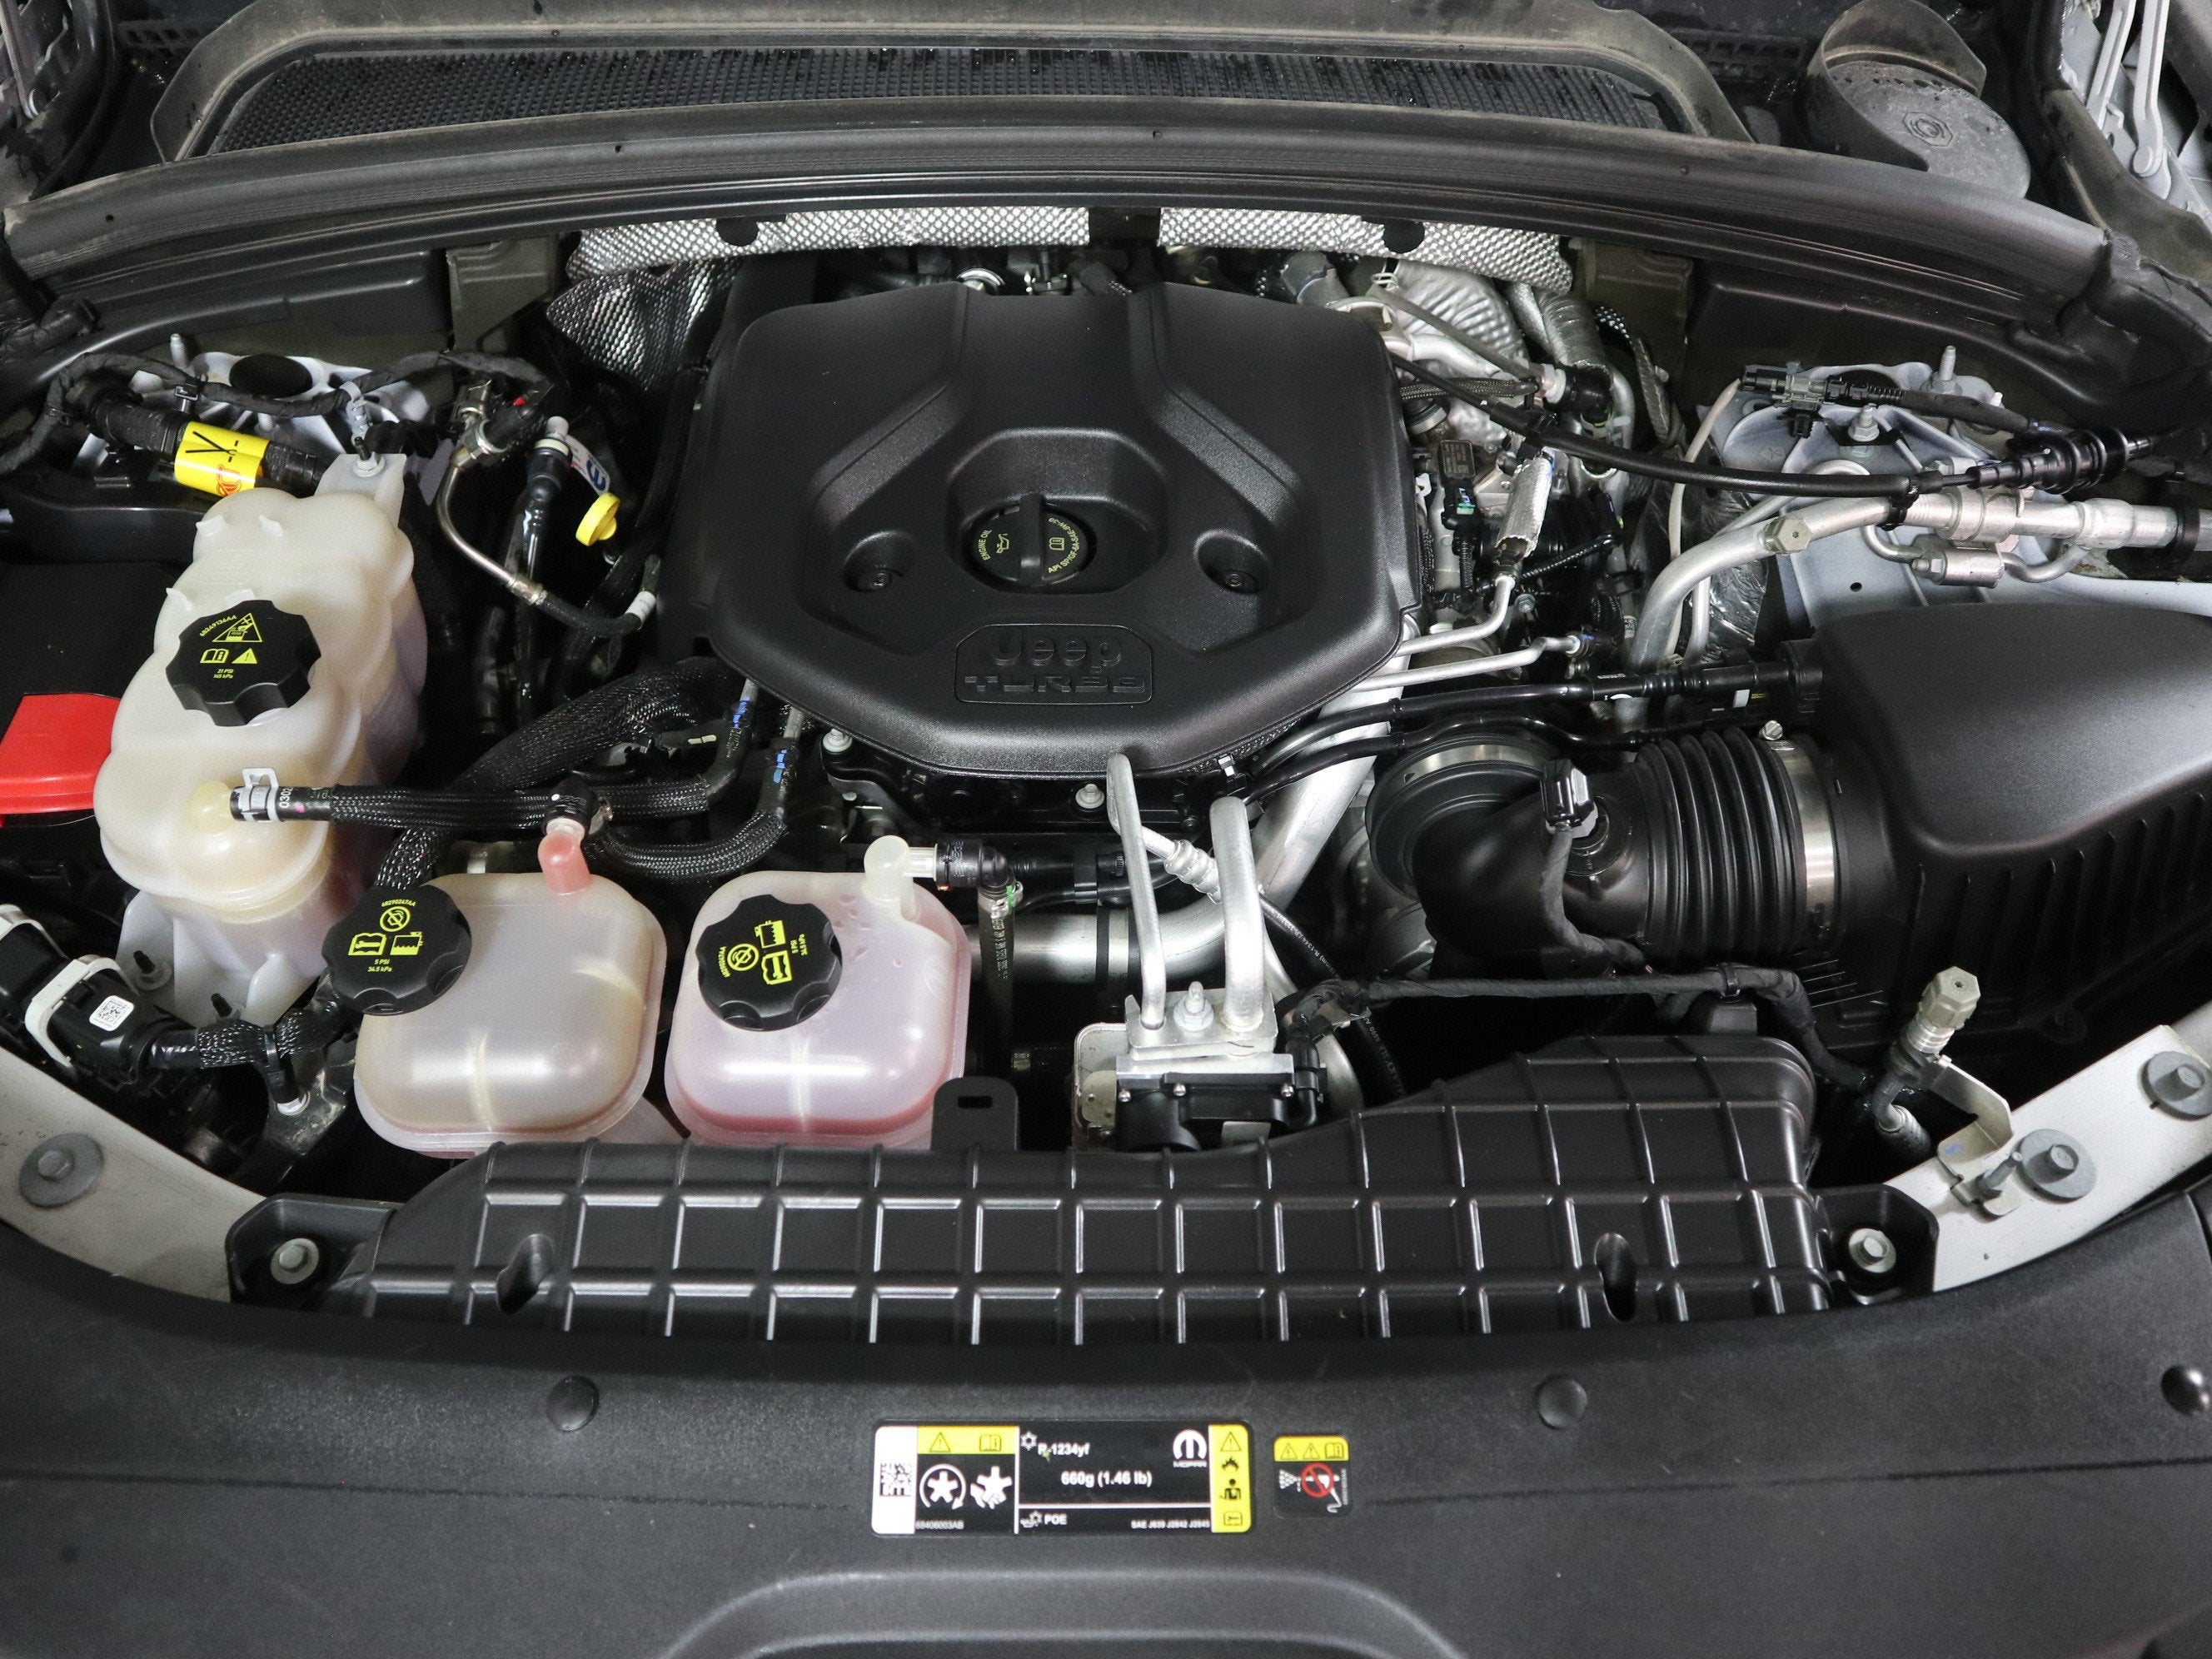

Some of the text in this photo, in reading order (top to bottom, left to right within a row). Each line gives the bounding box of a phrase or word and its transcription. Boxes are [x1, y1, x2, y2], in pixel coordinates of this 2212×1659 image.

[978, 529, 992, 560] ENGINE OIL
[1048, 565, 1063, 574] API
[990, 628, 1122, 674] Jeep
[964, 675, 1145, 693] TURBO
[1060, 1470, 1153, 1487] 660g (1.46 lb)
[1044, 1513, 1068, 1525] POE
[1131, 1520, 1148, 1529] SAE
